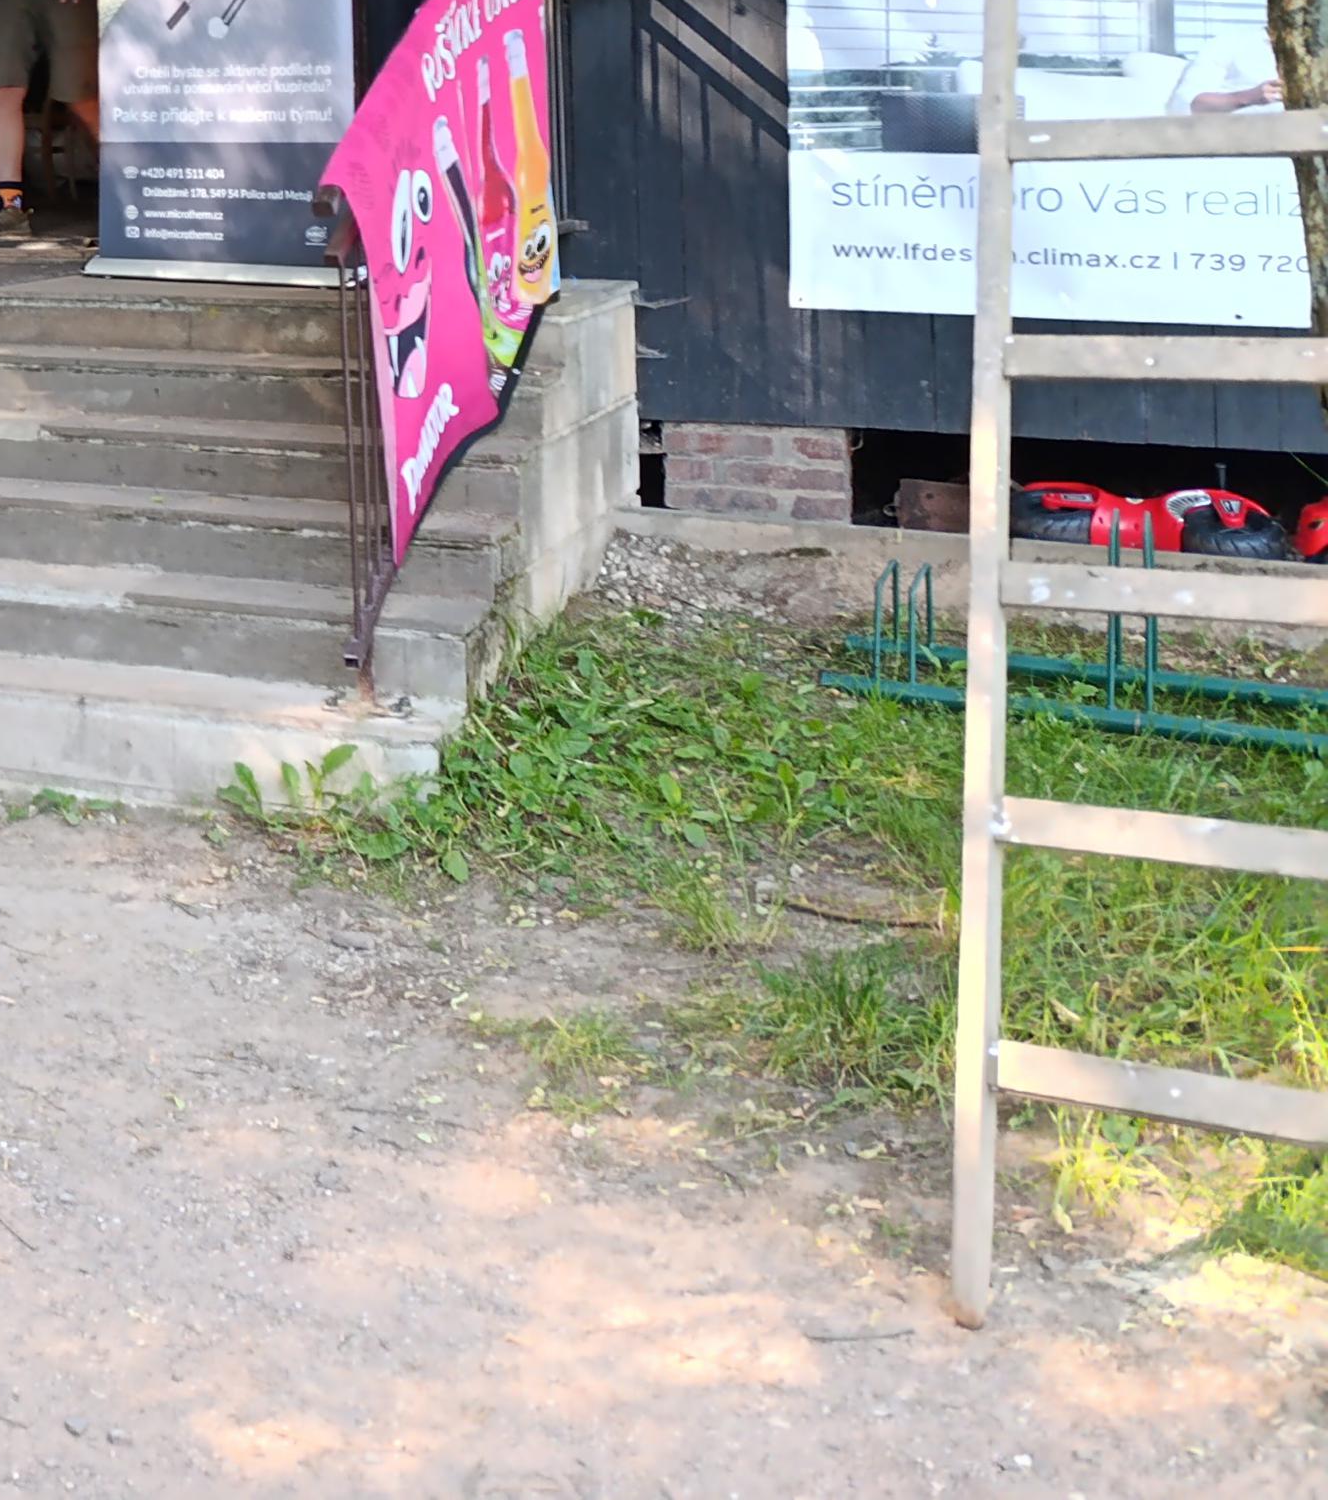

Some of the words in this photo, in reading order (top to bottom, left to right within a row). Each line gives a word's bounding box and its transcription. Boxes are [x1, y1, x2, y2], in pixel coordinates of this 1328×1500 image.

[315, 66, 331, 76] na
[112, 107, 138, 122] Pak
[142, 111, 158, 123] se
[289, 106, 332, 124] týmu!
[166, 168, 184, 179] 491
[186, 168, 204, 179] 511
[228, 189, 239, 199] 54
[240, 189, 266, 199] Police
[267, 190, 283, 200] nad
[831, 174, 977, 209] stínění
[1012, 185, 1063, 212] ro
[1079, 181, 1167, 214] Vás
[832, 243, 1161, 269] www.lfdes.climax.cz
[1190, 253, 1246, 271] 739
